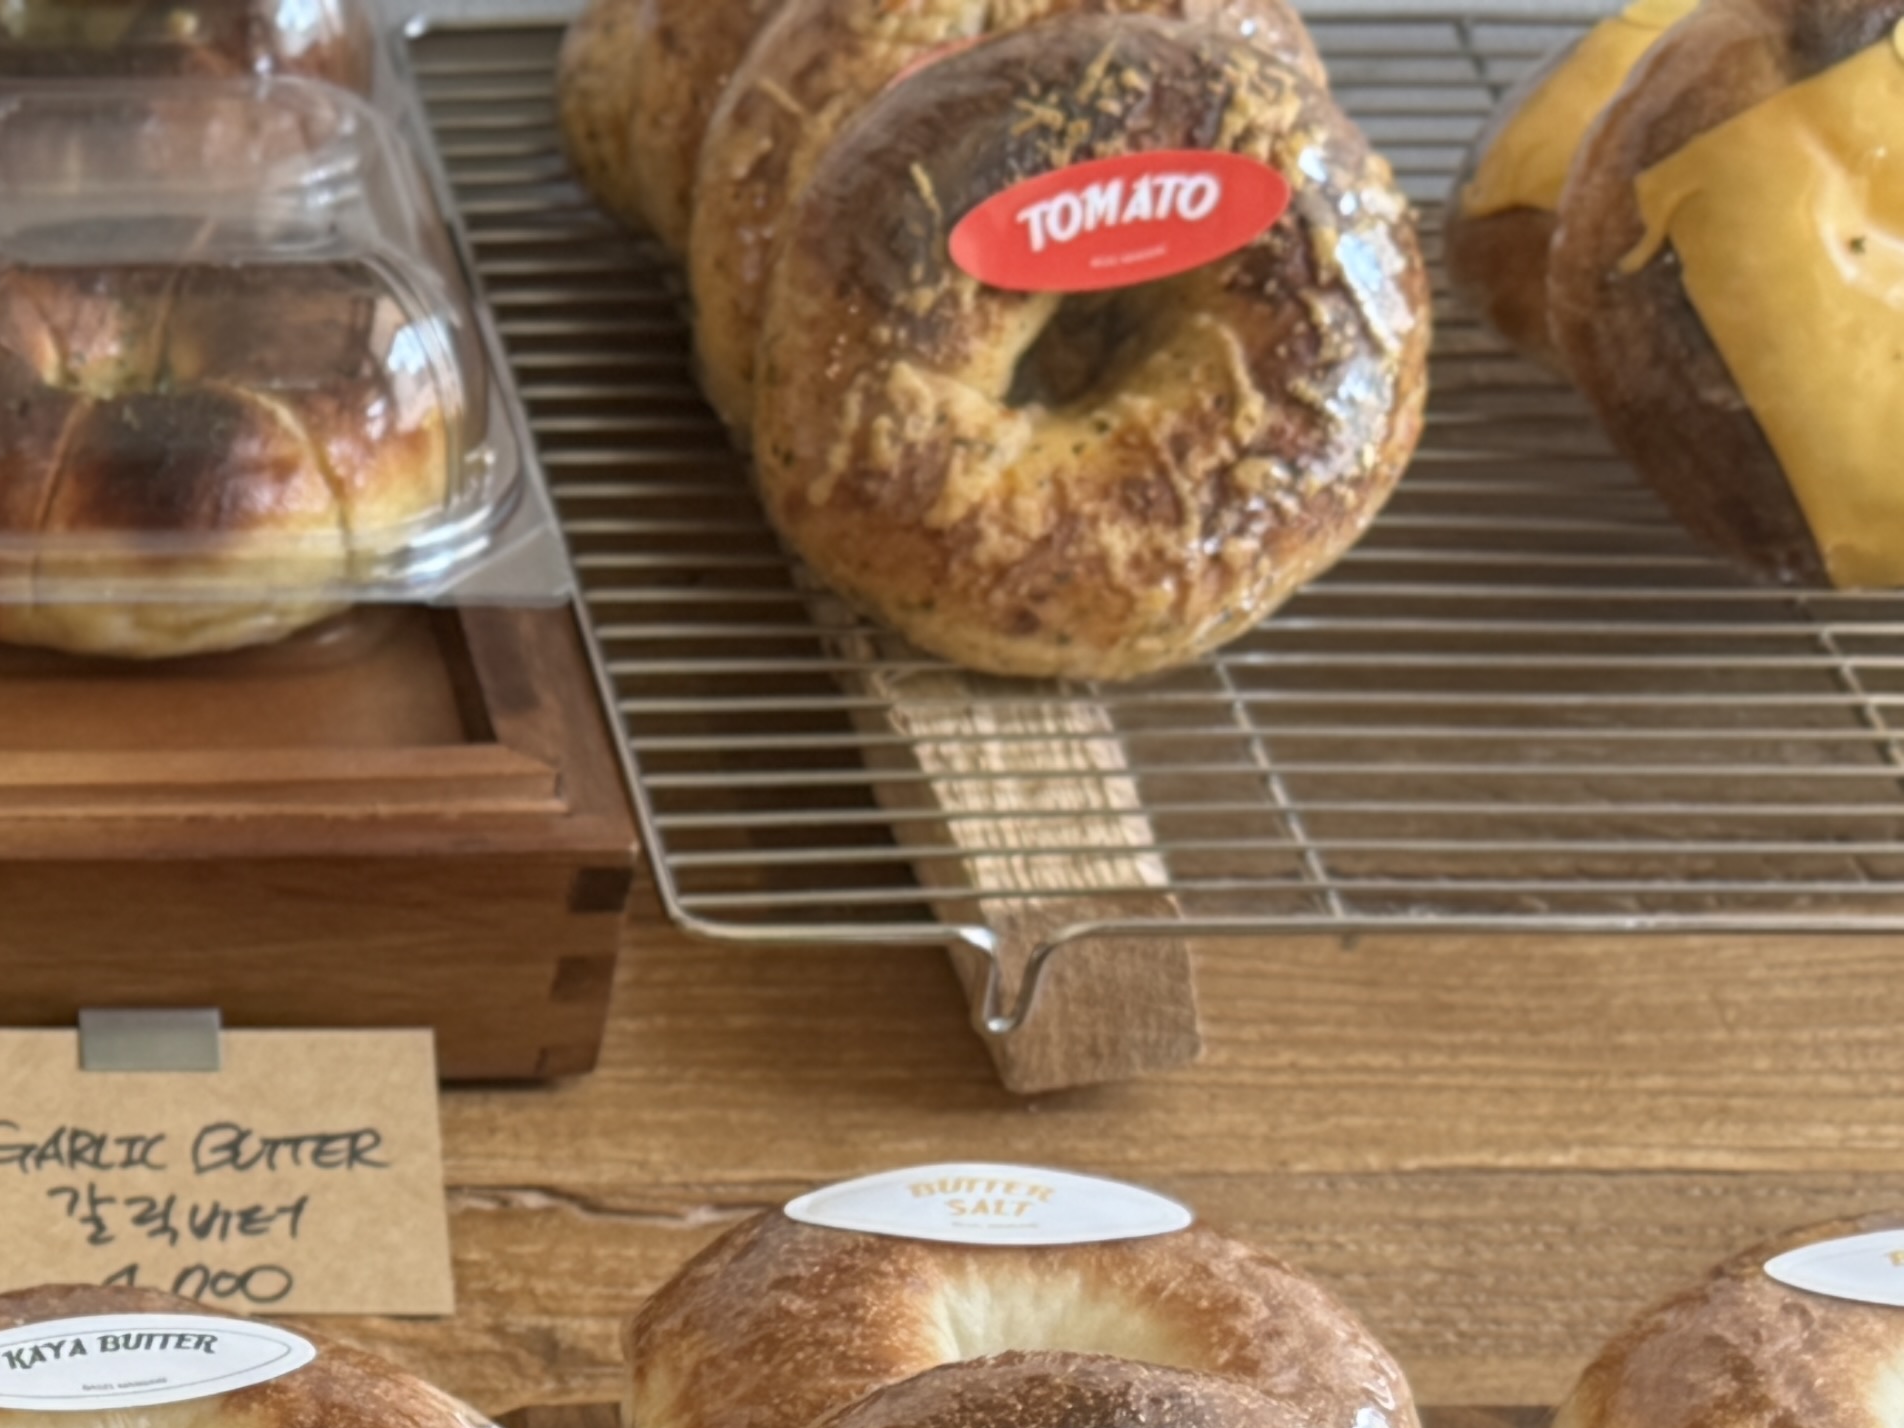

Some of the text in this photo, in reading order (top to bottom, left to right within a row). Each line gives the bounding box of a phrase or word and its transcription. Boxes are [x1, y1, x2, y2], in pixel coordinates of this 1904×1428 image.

[1016, 172, 1222, 253] TOMATO
[191, 1121, 391, 1175] BUTTER
[906, 1176, 1057, 1203] BUTTER
[944, 1198, 1035, 1217] SALT
[1, 1331, 219, 1371] KAYA BUTTER
